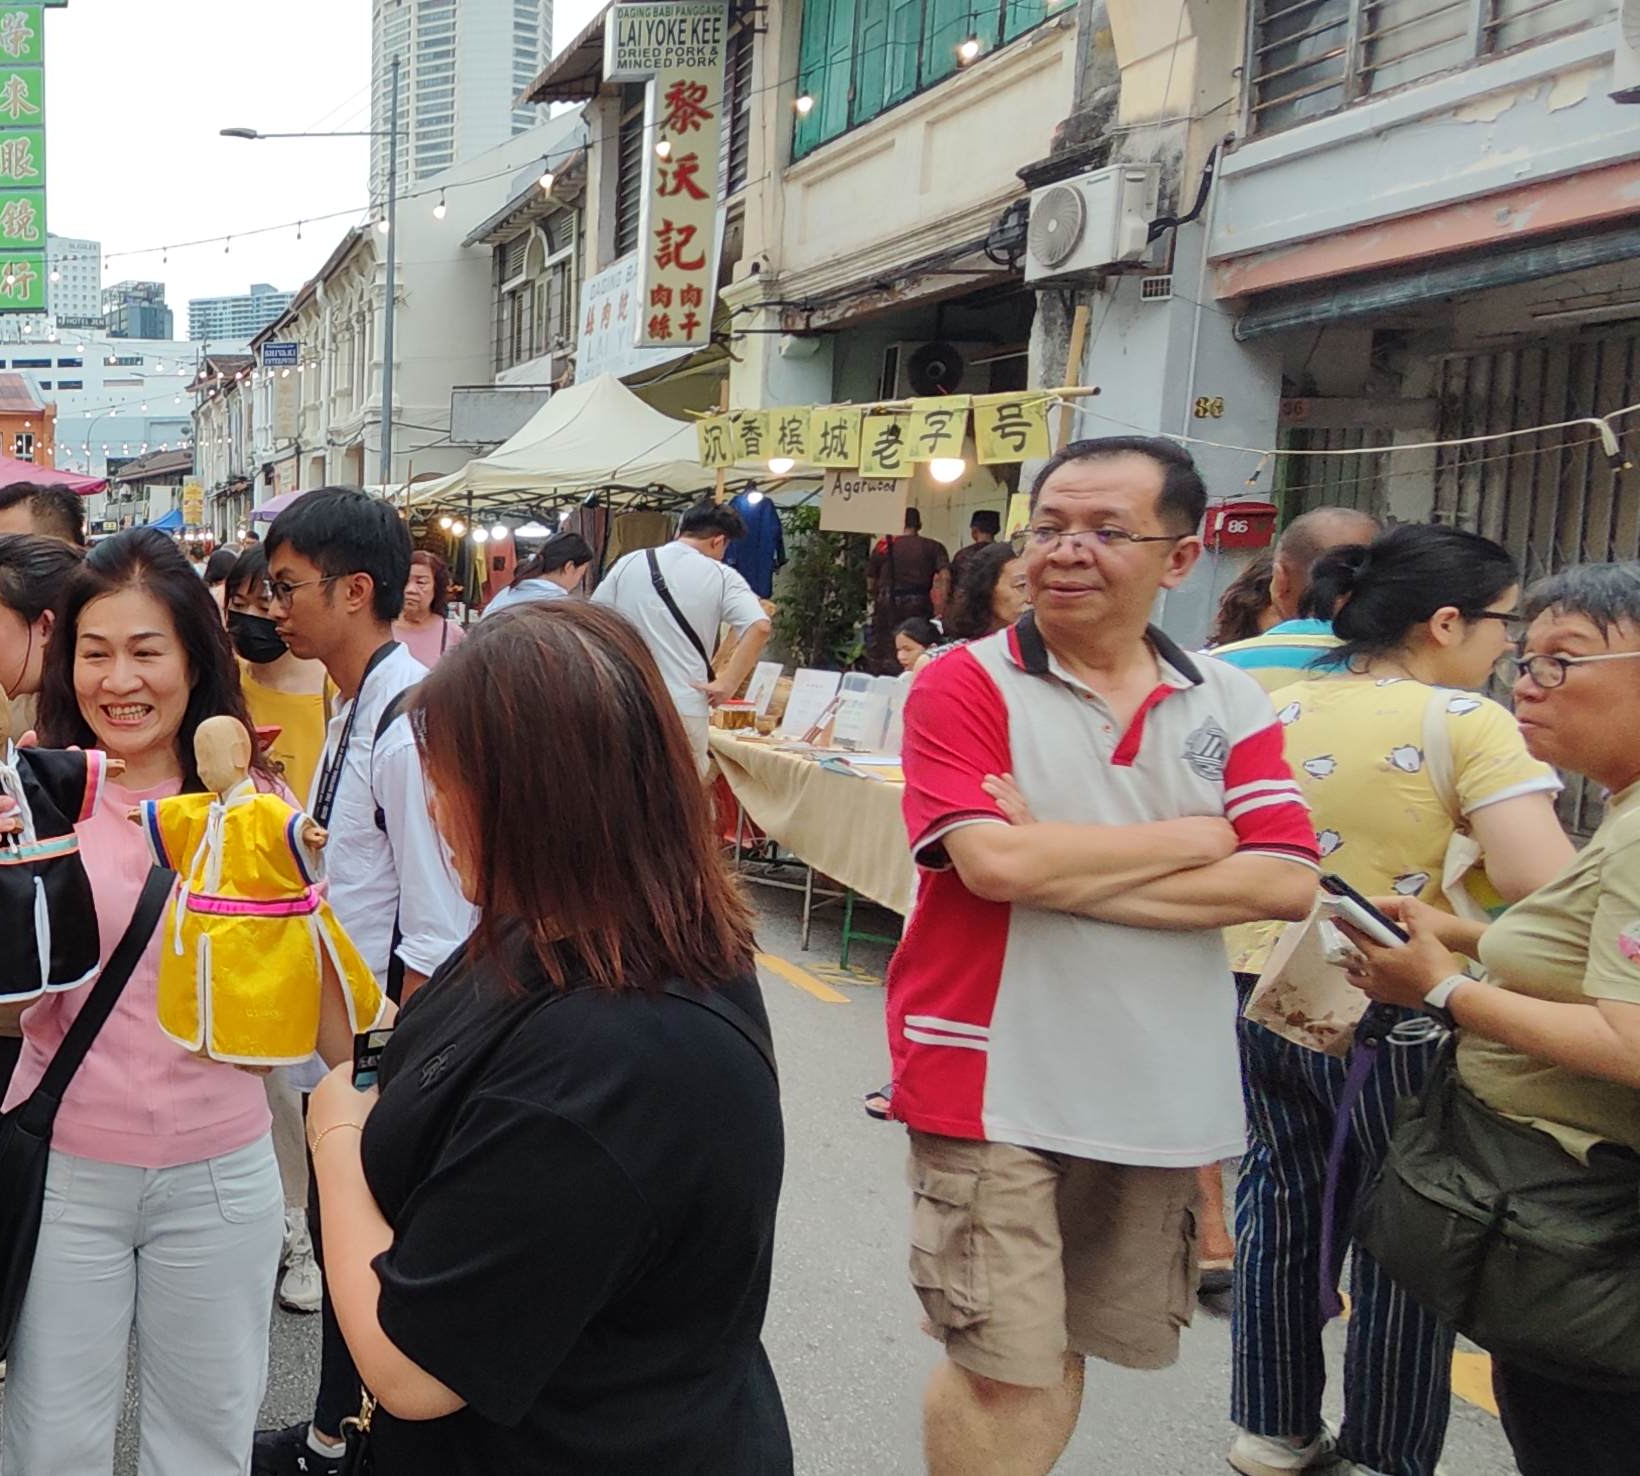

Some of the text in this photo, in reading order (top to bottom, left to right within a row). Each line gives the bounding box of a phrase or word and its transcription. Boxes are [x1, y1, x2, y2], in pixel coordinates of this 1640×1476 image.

[617, 5, 724, 18] DAGING BABI PANGGANG
[618, 17, 721, 47] LAI YOKE KEE
[617, 46, 718, 58] DRIED PORK &
[617, 56, 717, 69] MINCED PORK
[831, 472, 897, 502] Agarwood
[1228, 519, 1249, 533] 86
